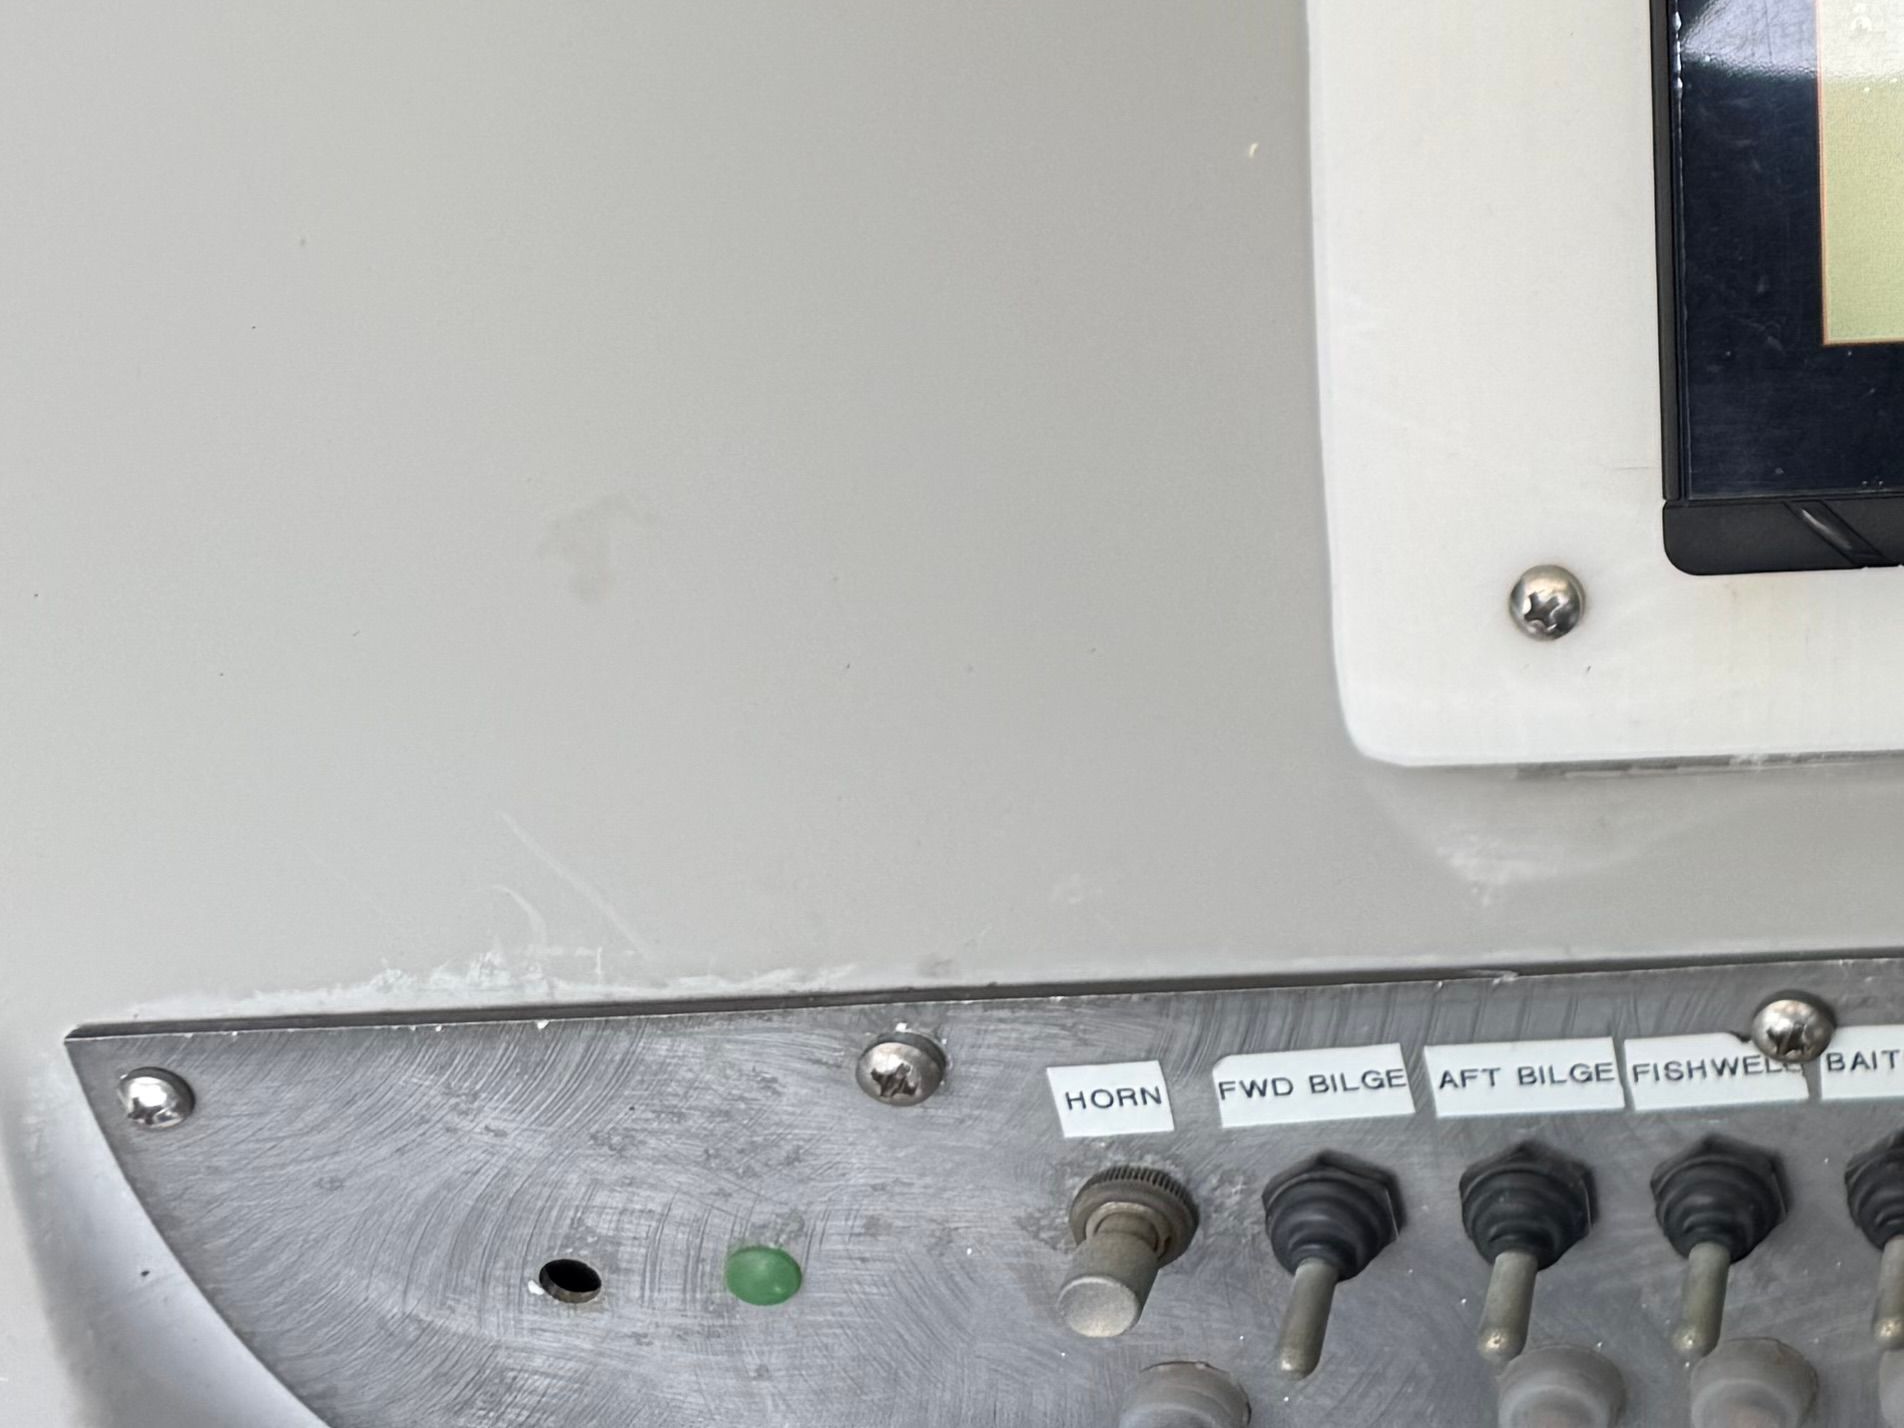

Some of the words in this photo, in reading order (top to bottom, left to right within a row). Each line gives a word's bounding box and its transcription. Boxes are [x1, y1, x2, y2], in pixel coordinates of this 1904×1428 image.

[1219, 1076, 1294, 1101] FWD
[1310, 1068, 1408, 1095] BILGE
[1438, 1066, 1502, 1090] AFT
[1517, 1061, 1616, 1086] BILGE
[1064, 1084, 1164, 1111] HORN
